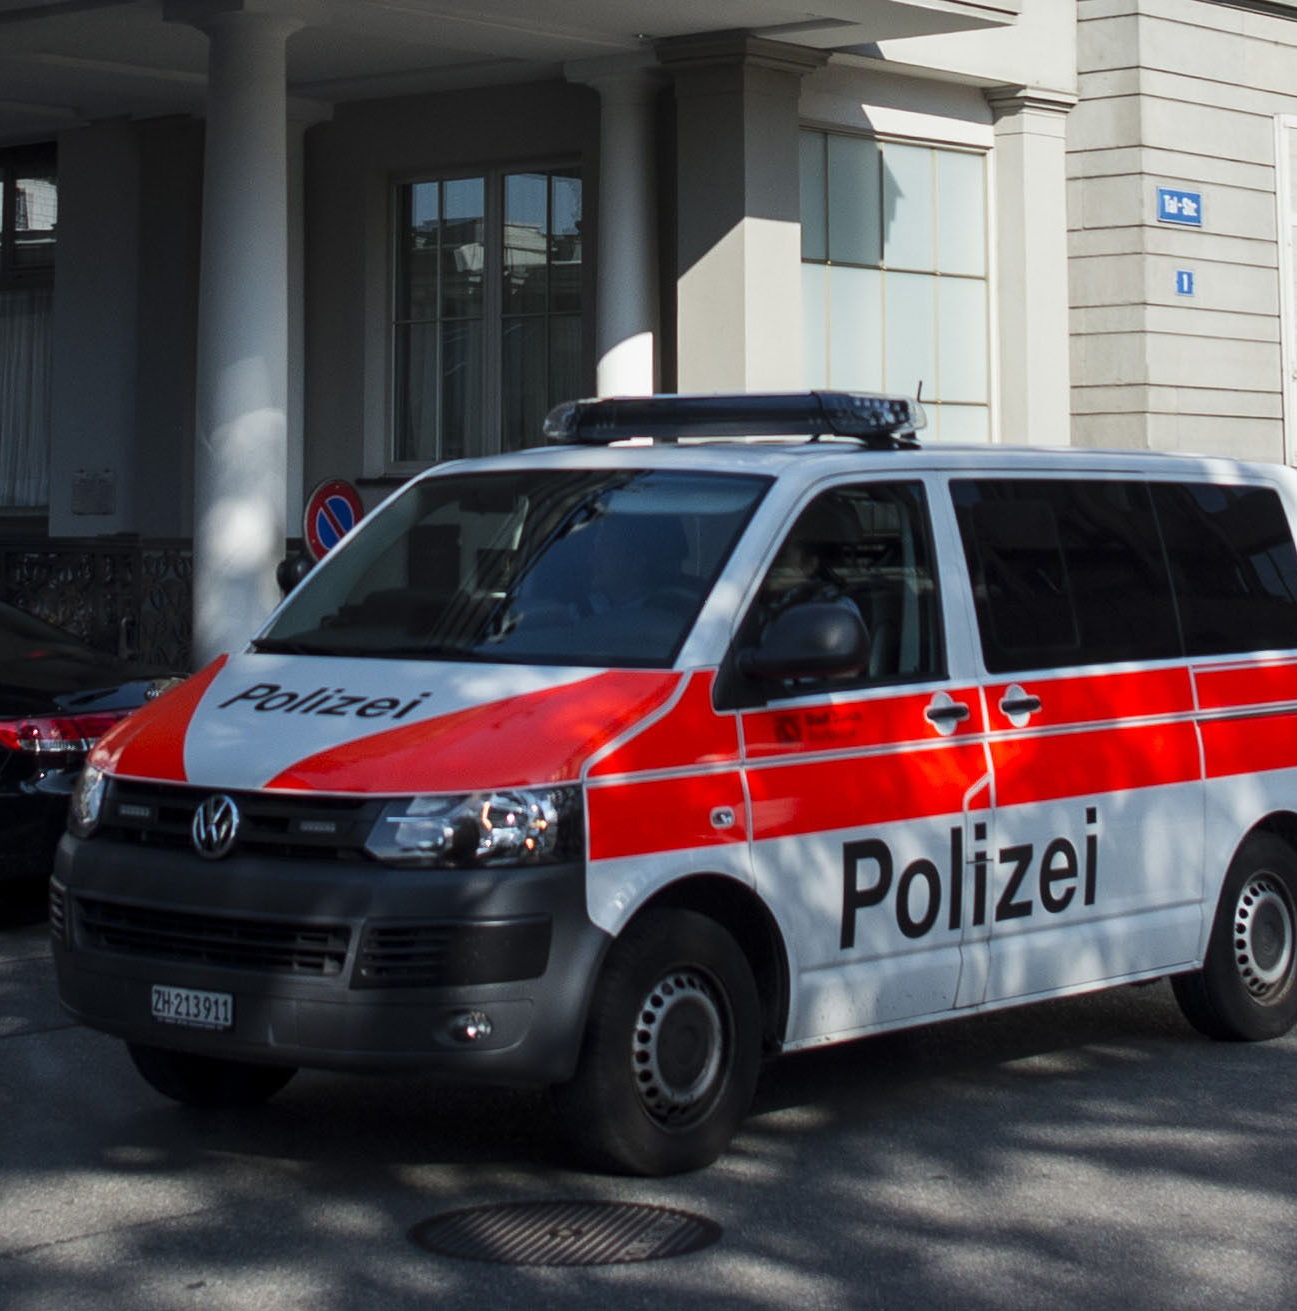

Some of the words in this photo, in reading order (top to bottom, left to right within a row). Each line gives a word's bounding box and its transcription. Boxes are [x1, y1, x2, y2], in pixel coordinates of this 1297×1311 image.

[1181, 273, 1189, 292] 1
[217, 682, 430, 720] Polizei
[839, 806, 1099, 949] Polizei
